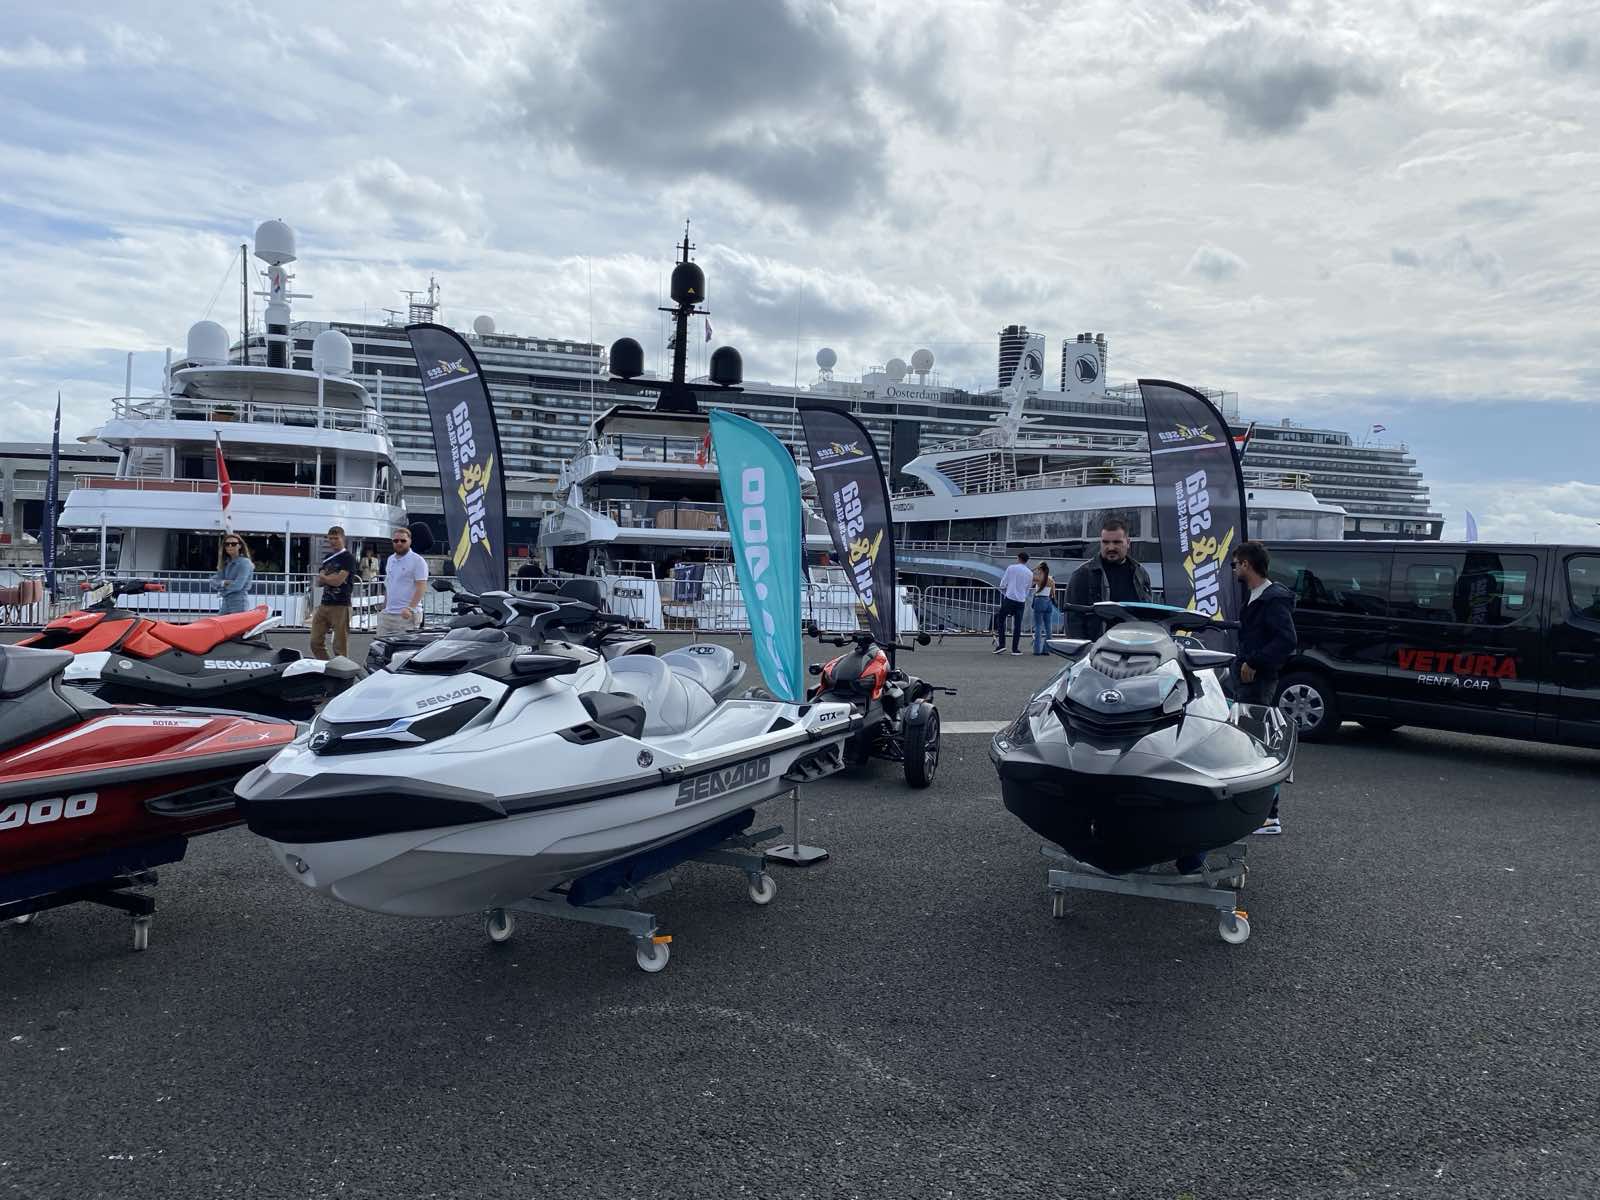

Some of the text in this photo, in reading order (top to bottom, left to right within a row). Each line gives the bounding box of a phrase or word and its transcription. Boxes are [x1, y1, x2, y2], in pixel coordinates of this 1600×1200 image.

[887, 386, 939, 400] Oosterdam
[1397, 647, 1518, 679] VETURA
[1417, 674, 1490, 691] RENT A CAR
[819, 711, 837, 722] GTX
